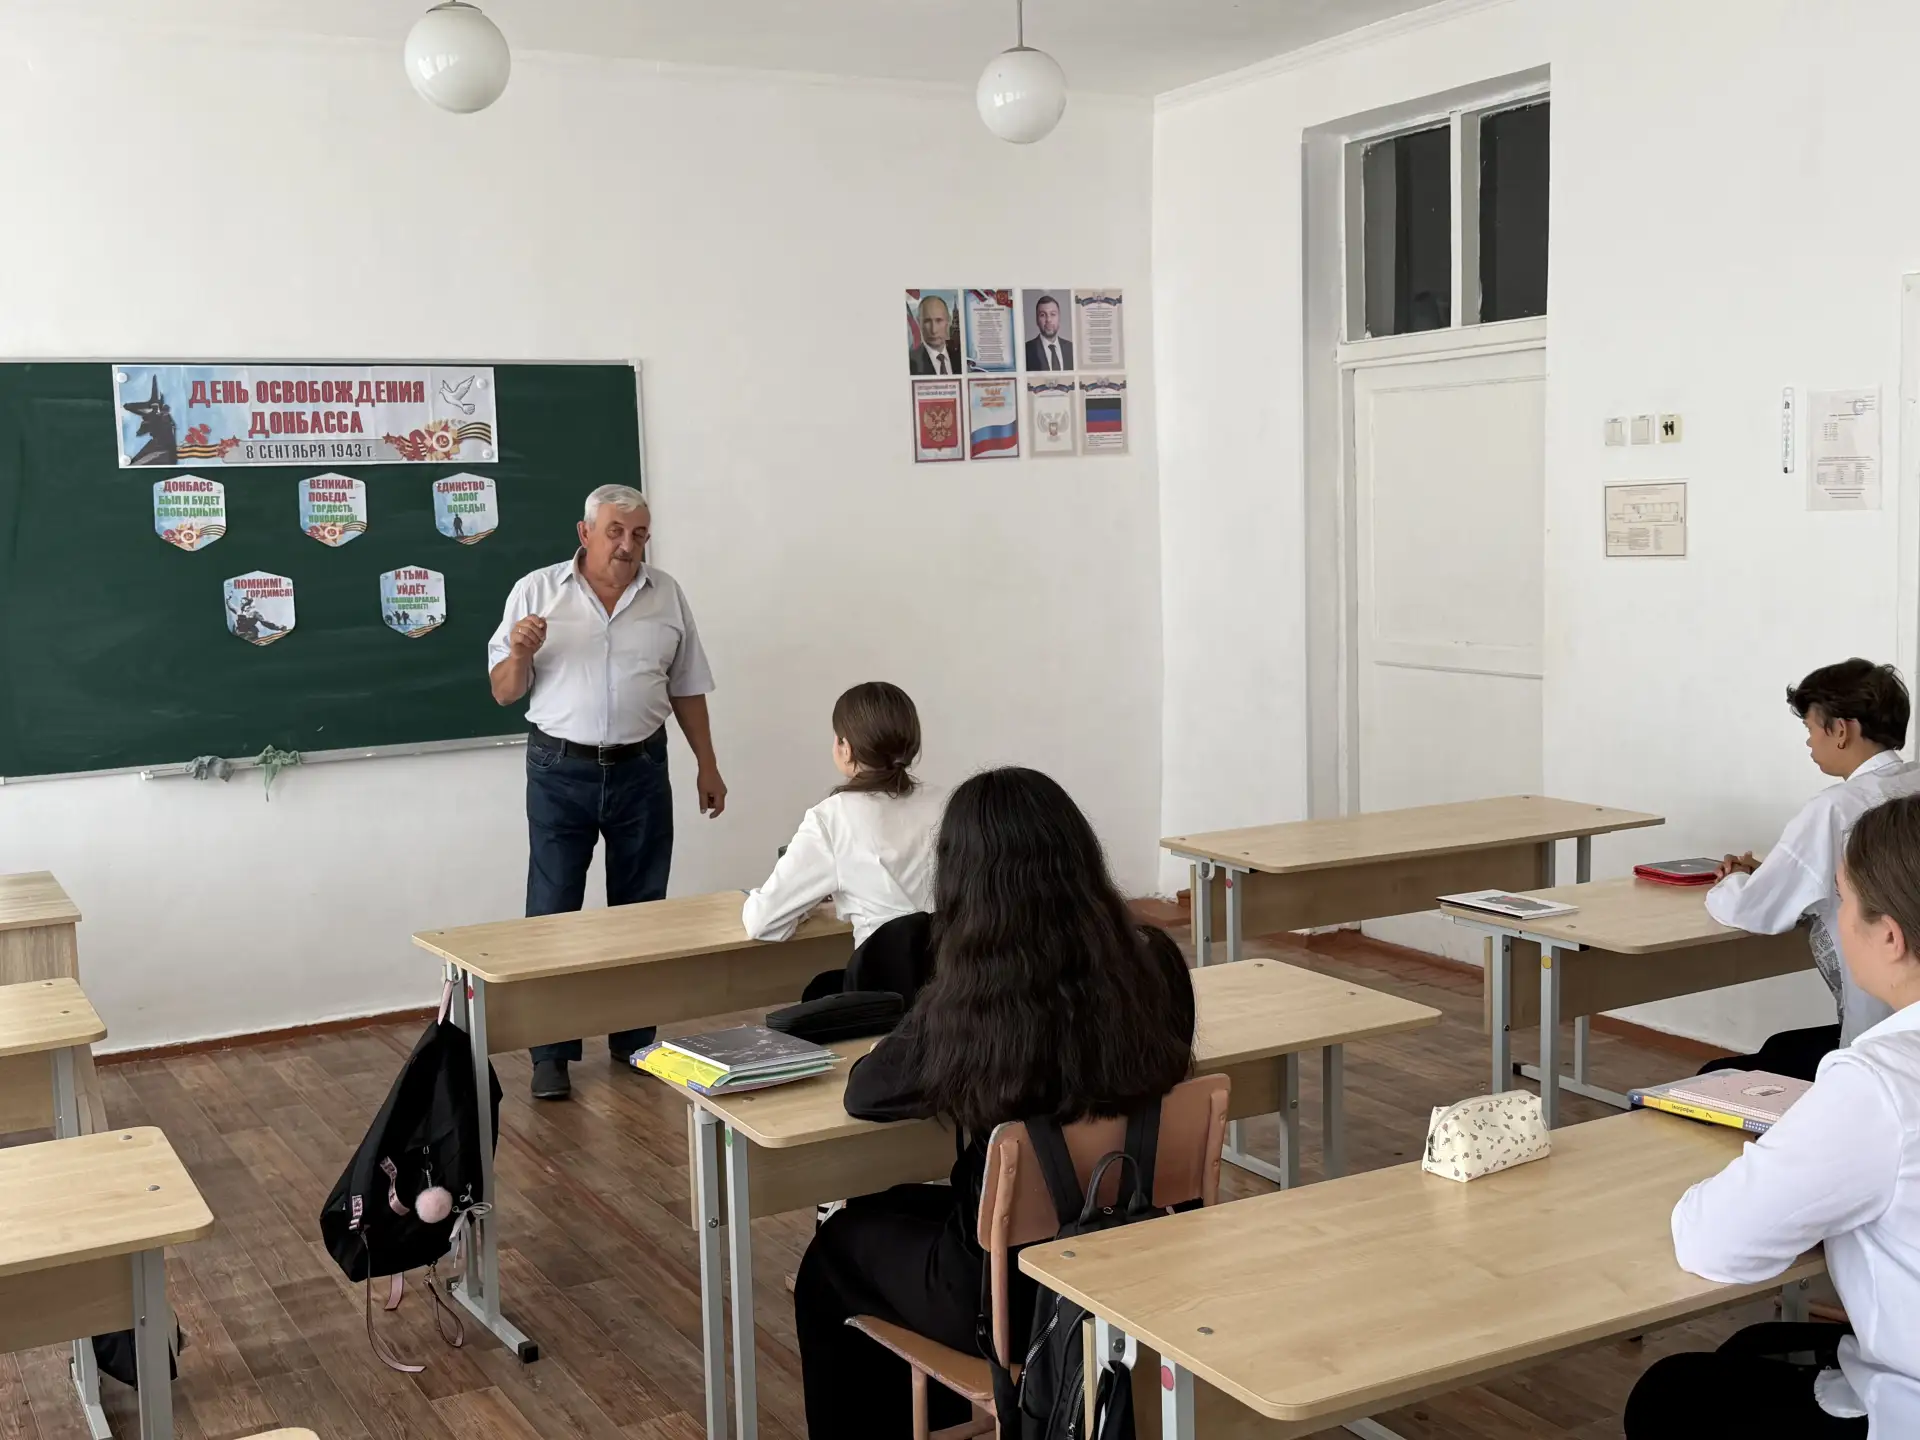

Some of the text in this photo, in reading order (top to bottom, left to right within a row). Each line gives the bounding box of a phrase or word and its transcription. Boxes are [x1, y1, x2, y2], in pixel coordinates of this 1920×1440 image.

[188, 380, 425, 408] ДЕНЬ ОСВОБОЖДЕНИЯ
[248, 411, 364, 438] ДОНБАССА
[246, 445, 254, 460] 8
[260, 444, 326, 460] СЕНТЯБРЯ
[330, 443, 362, 459] 1943
[163, 481, 213, 493] ДОНБАСС
[309, 479, 354, 489] ВЕЛИКАЯ
[437, 481, 485, 493] ЕДИНСТВО
[158, 496, 220, 506] БЫЛ И БУДЕТ
[308, 492, 347, 503] ПОБЕДА
[452, 492, 478, 502] ЗАЛОГ
[157, 507, 223, 518] СВОБОДНЫМ!
[312, 504, 352, 513] ГОРДОСТЬ
[447, 503, 486, 513] ПОБЕДЫ!
[394, 570, 429, 580] И ТЬМА
[233, 578, 282, 589] ПОМНИМ!
[246, 588, 293, 598] ГОРДИМСЯ!
